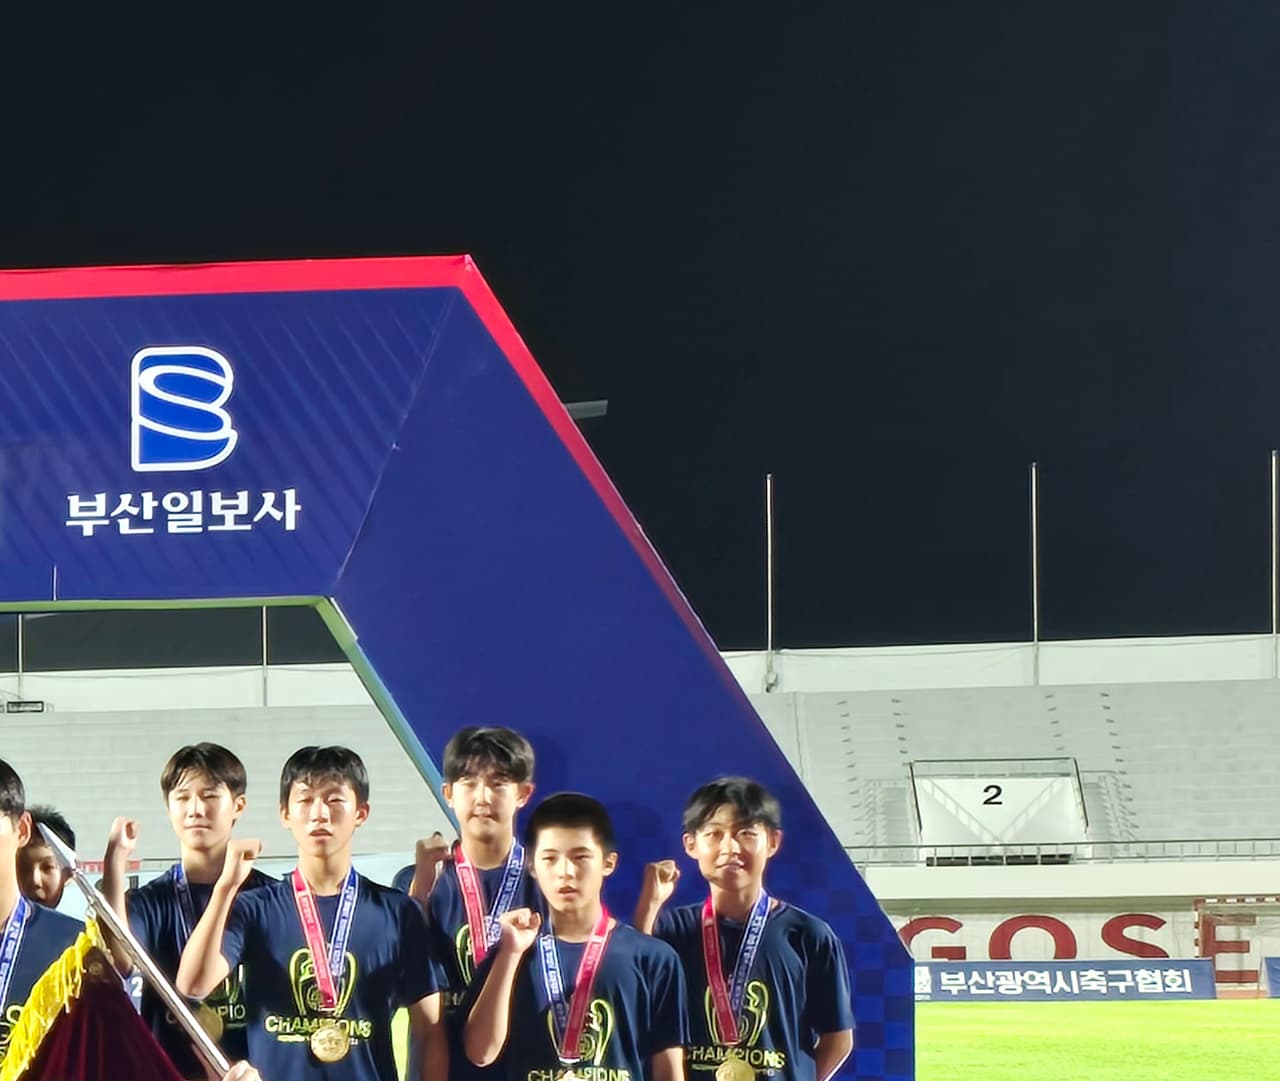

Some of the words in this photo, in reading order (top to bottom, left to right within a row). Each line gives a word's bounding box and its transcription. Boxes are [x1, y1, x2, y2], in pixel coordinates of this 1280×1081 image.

[65, 488, 302, 537] 부산일보사
[982, 785, 1003, 806] 2
[939, 968, 1193, 996] 부산광역시축구협회
